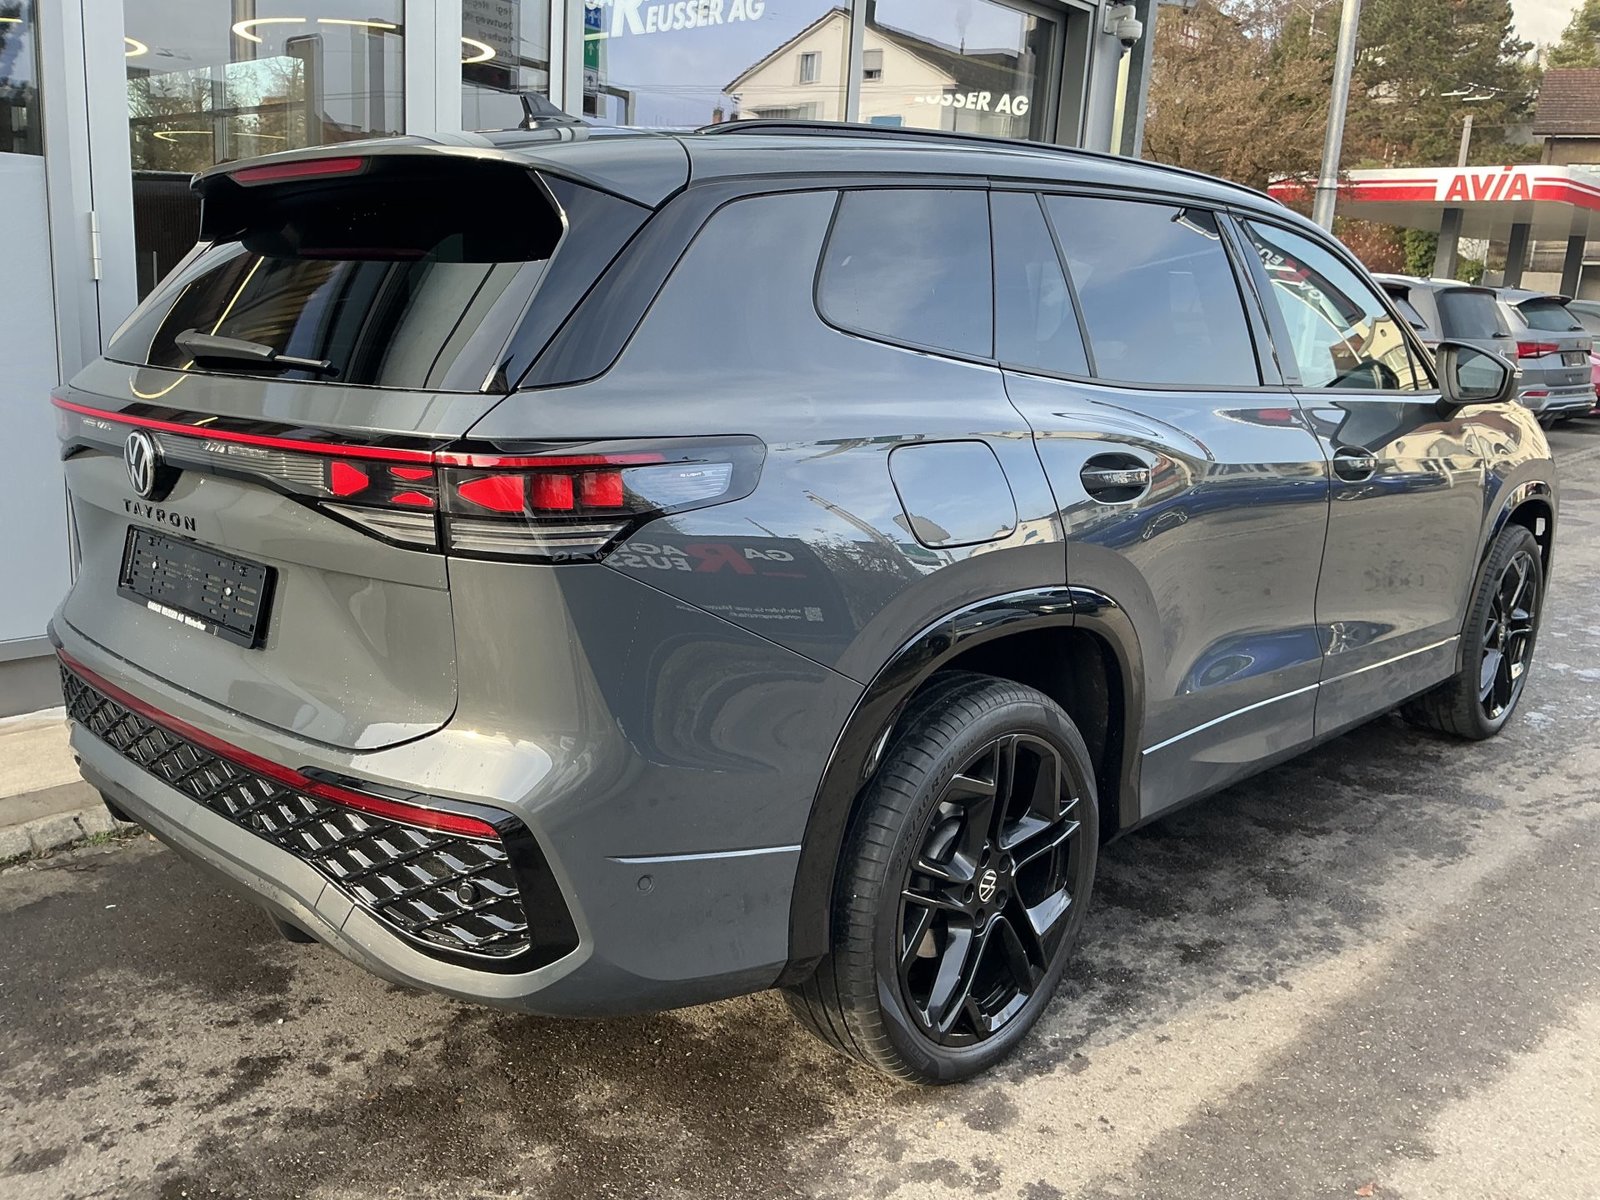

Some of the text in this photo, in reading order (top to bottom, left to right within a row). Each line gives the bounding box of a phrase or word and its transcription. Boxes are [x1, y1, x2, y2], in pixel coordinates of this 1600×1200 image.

[727, 0, 766, 23] AG
[995, 94, 1029, 116] AG
[1445, 166, 1530, 201] AVIA
[122, 498, 196, 532] TAYRON
